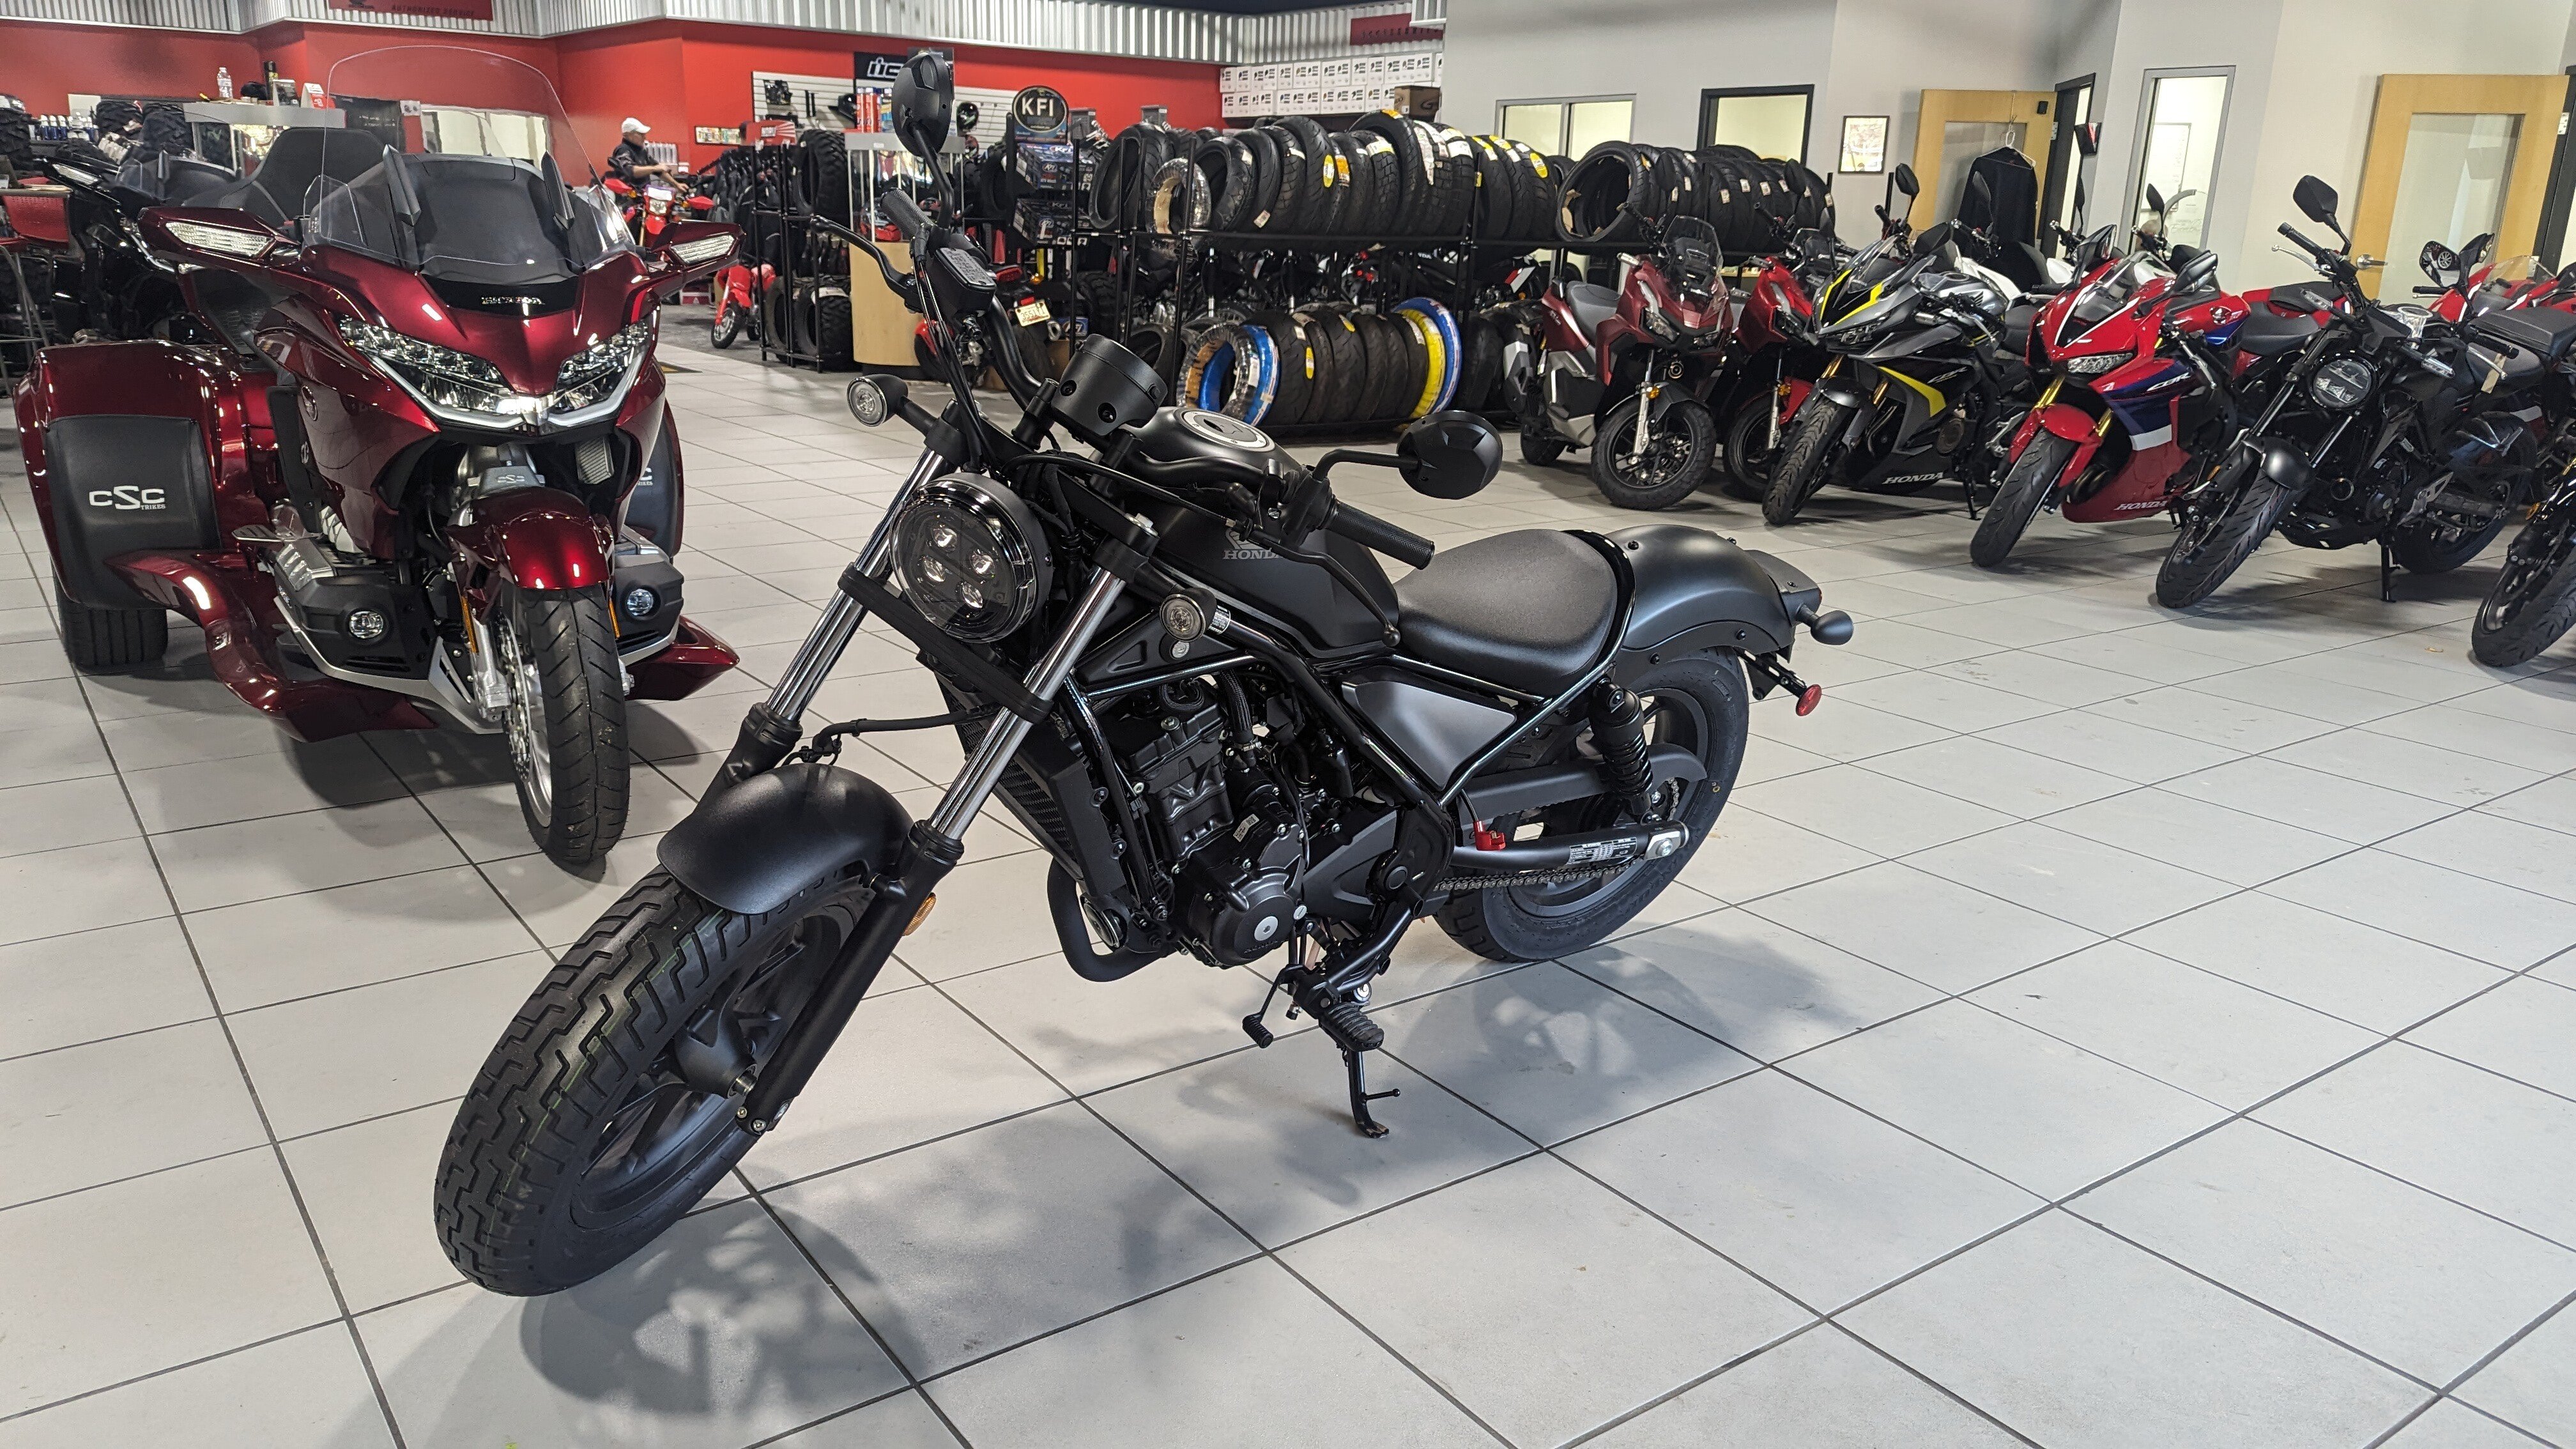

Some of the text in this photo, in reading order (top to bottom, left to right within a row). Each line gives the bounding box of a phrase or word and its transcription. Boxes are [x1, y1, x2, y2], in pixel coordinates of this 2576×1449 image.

[1022, 96, 1054, 116] KFI
[2147, 372, 2191, 392] CBR
[1882, 471, 1943, 484] HONDA
[2113, 500, 2168, 510] HONDA
